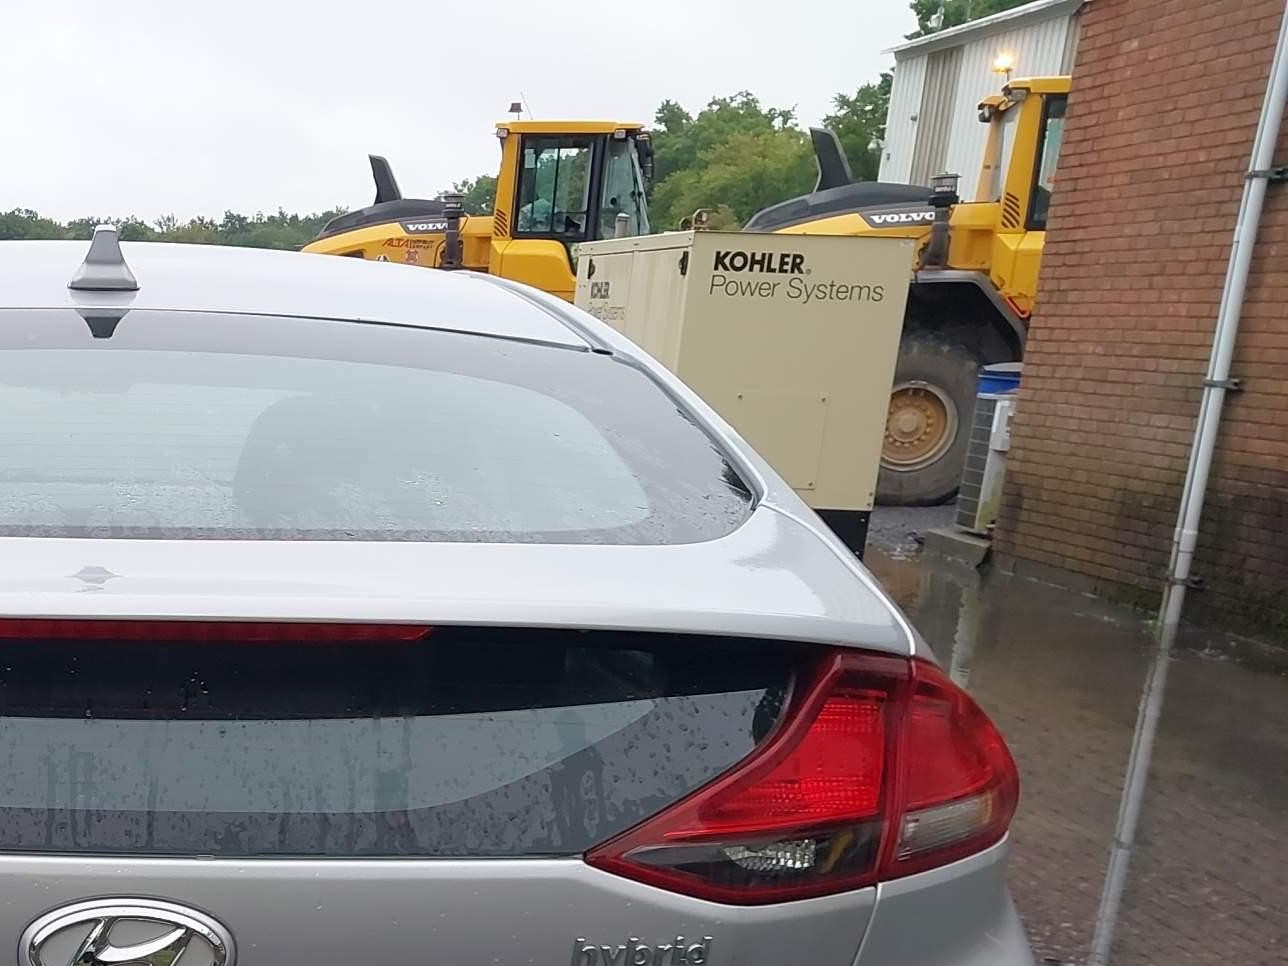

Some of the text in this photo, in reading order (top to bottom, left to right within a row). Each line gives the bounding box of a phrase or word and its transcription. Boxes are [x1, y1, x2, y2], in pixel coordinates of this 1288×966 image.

[869, 211, 936, 223] VOLVO
[407, 223, 448, 231] VOLV
[713, 250, 806, 275] KOHLER
[709, 274, 885, 305] Power Systems
